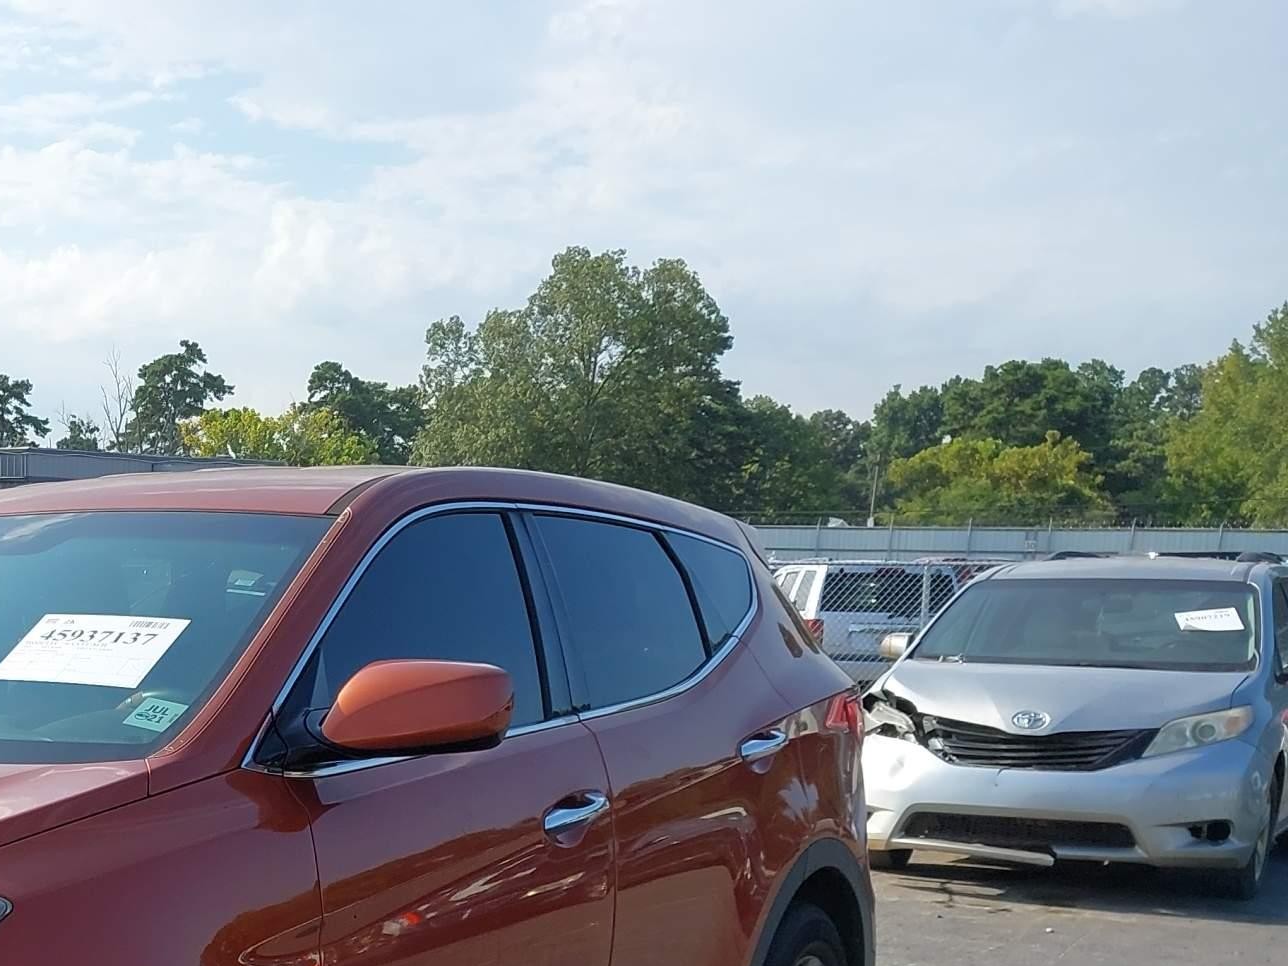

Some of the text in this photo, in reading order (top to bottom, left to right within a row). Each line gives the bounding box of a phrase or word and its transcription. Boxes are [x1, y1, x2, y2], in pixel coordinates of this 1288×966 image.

[40, 629, 159, 646] 45937137
[144, 704, 169, 716] JUL
[147, 714, 164, 724] 21
